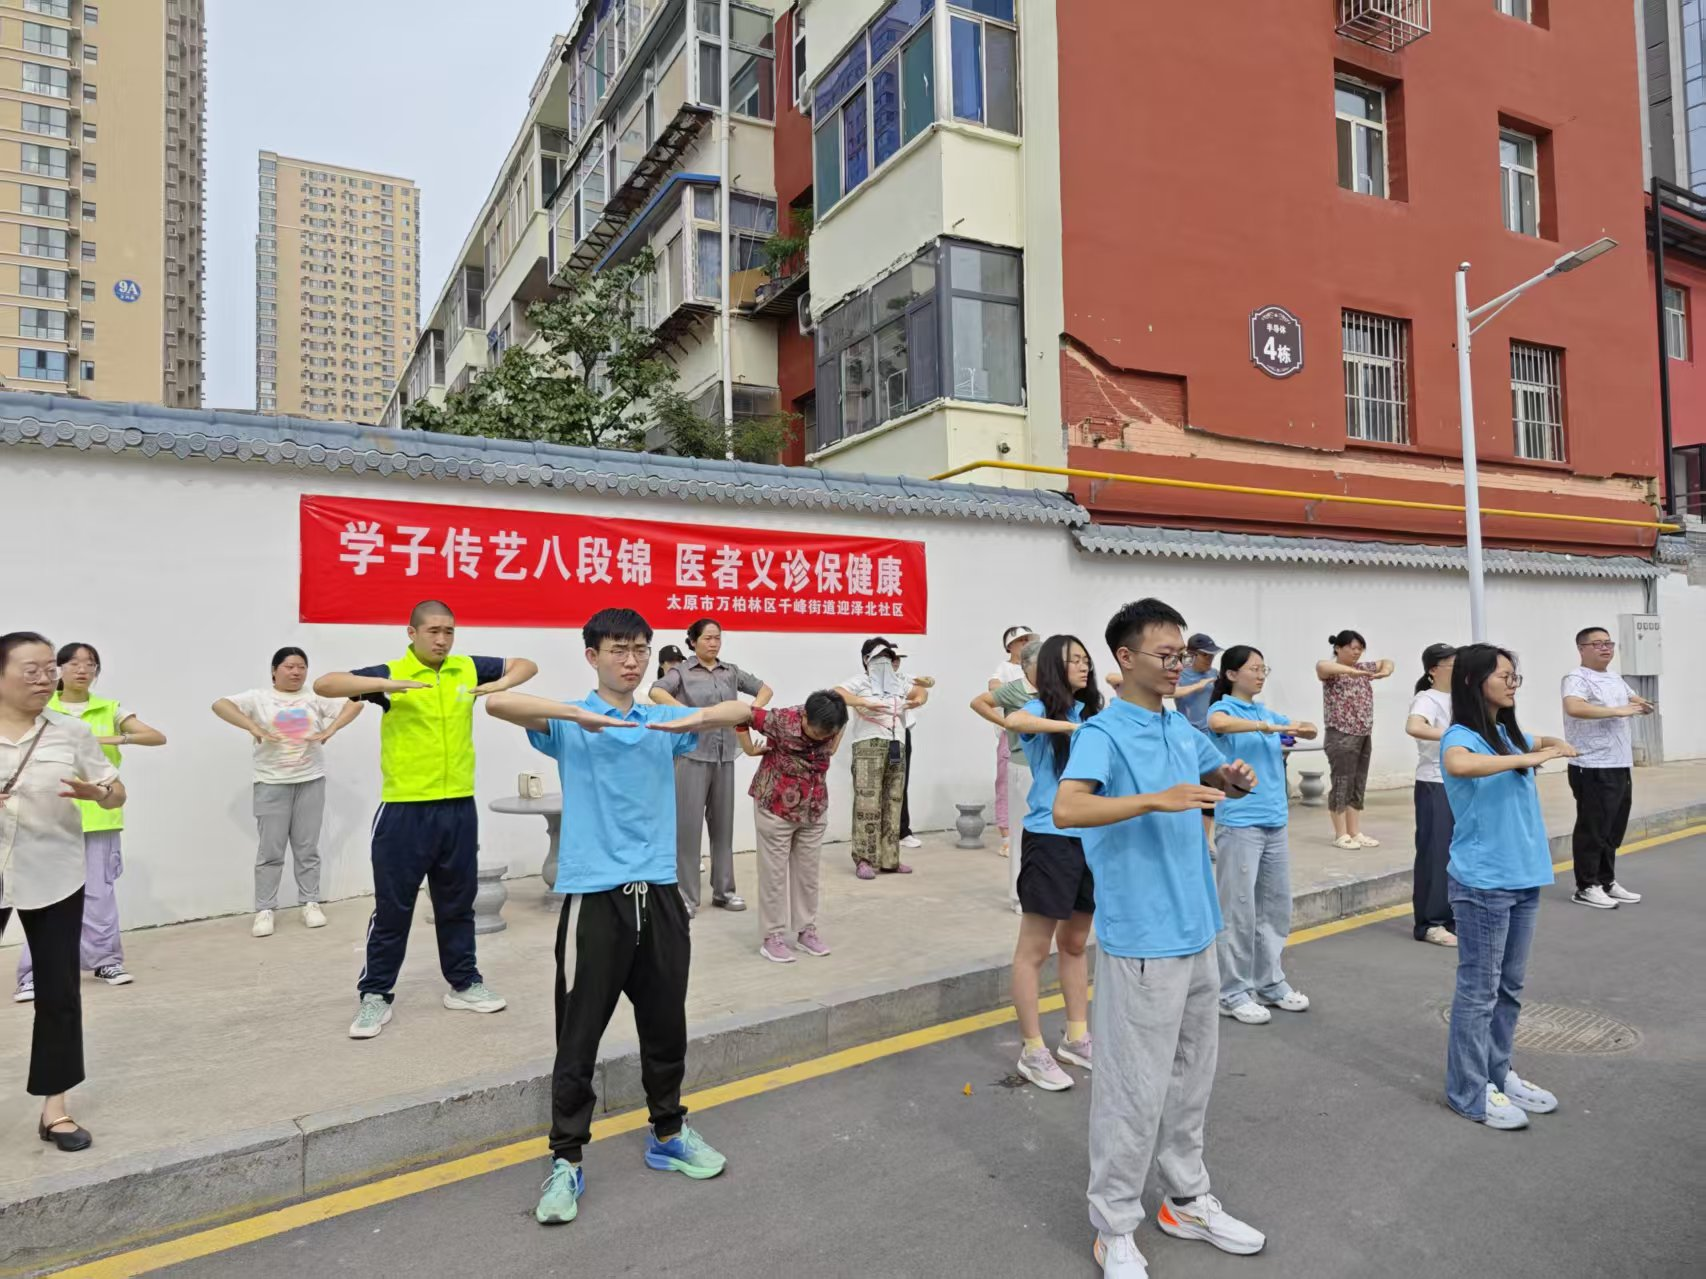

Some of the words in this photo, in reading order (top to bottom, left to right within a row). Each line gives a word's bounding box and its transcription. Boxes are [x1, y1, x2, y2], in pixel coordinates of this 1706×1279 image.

[118, 280, 138, 294] 9A
[1263, 336, 1292, 364] 4栋
[339, 520, 653, 587] 学子传艺八段锦
[675, 542, 904, 598] 医者义诊保健康
[666, 593, 905, 617] 太原市万柏林区千峰街道迎泽北社区
